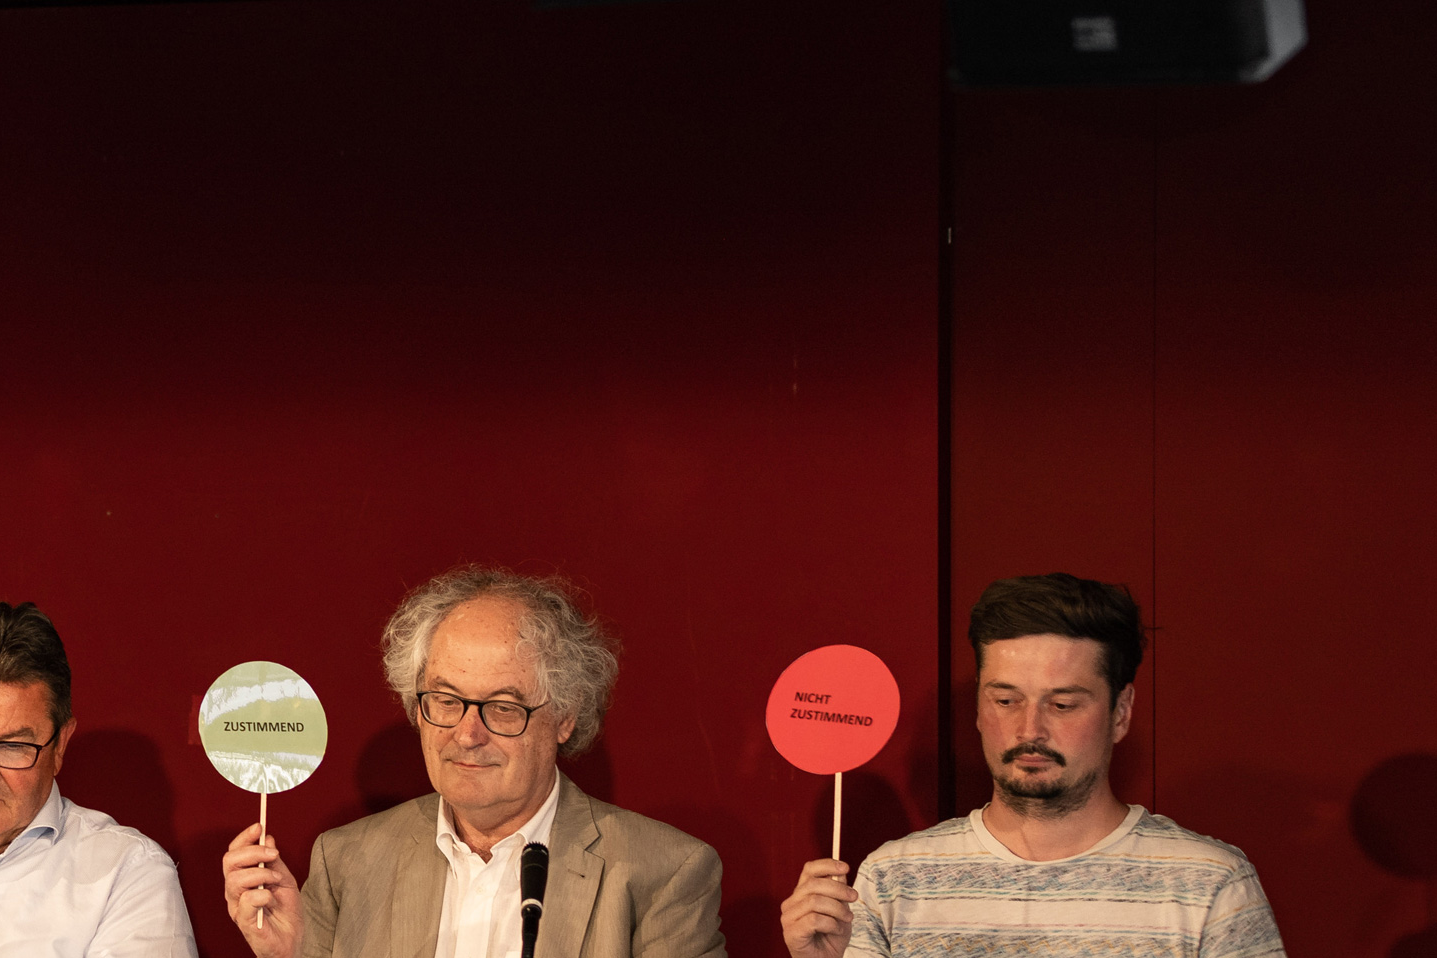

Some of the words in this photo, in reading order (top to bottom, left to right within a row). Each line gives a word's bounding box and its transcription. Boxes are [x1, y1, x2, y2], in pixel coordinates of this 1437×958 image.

[794, 691, 832, 705] NICHT
[790, 708, 873, 727] ZUSTIMMEND
[223, 721, 305, 732] ZUSTIMMEND
